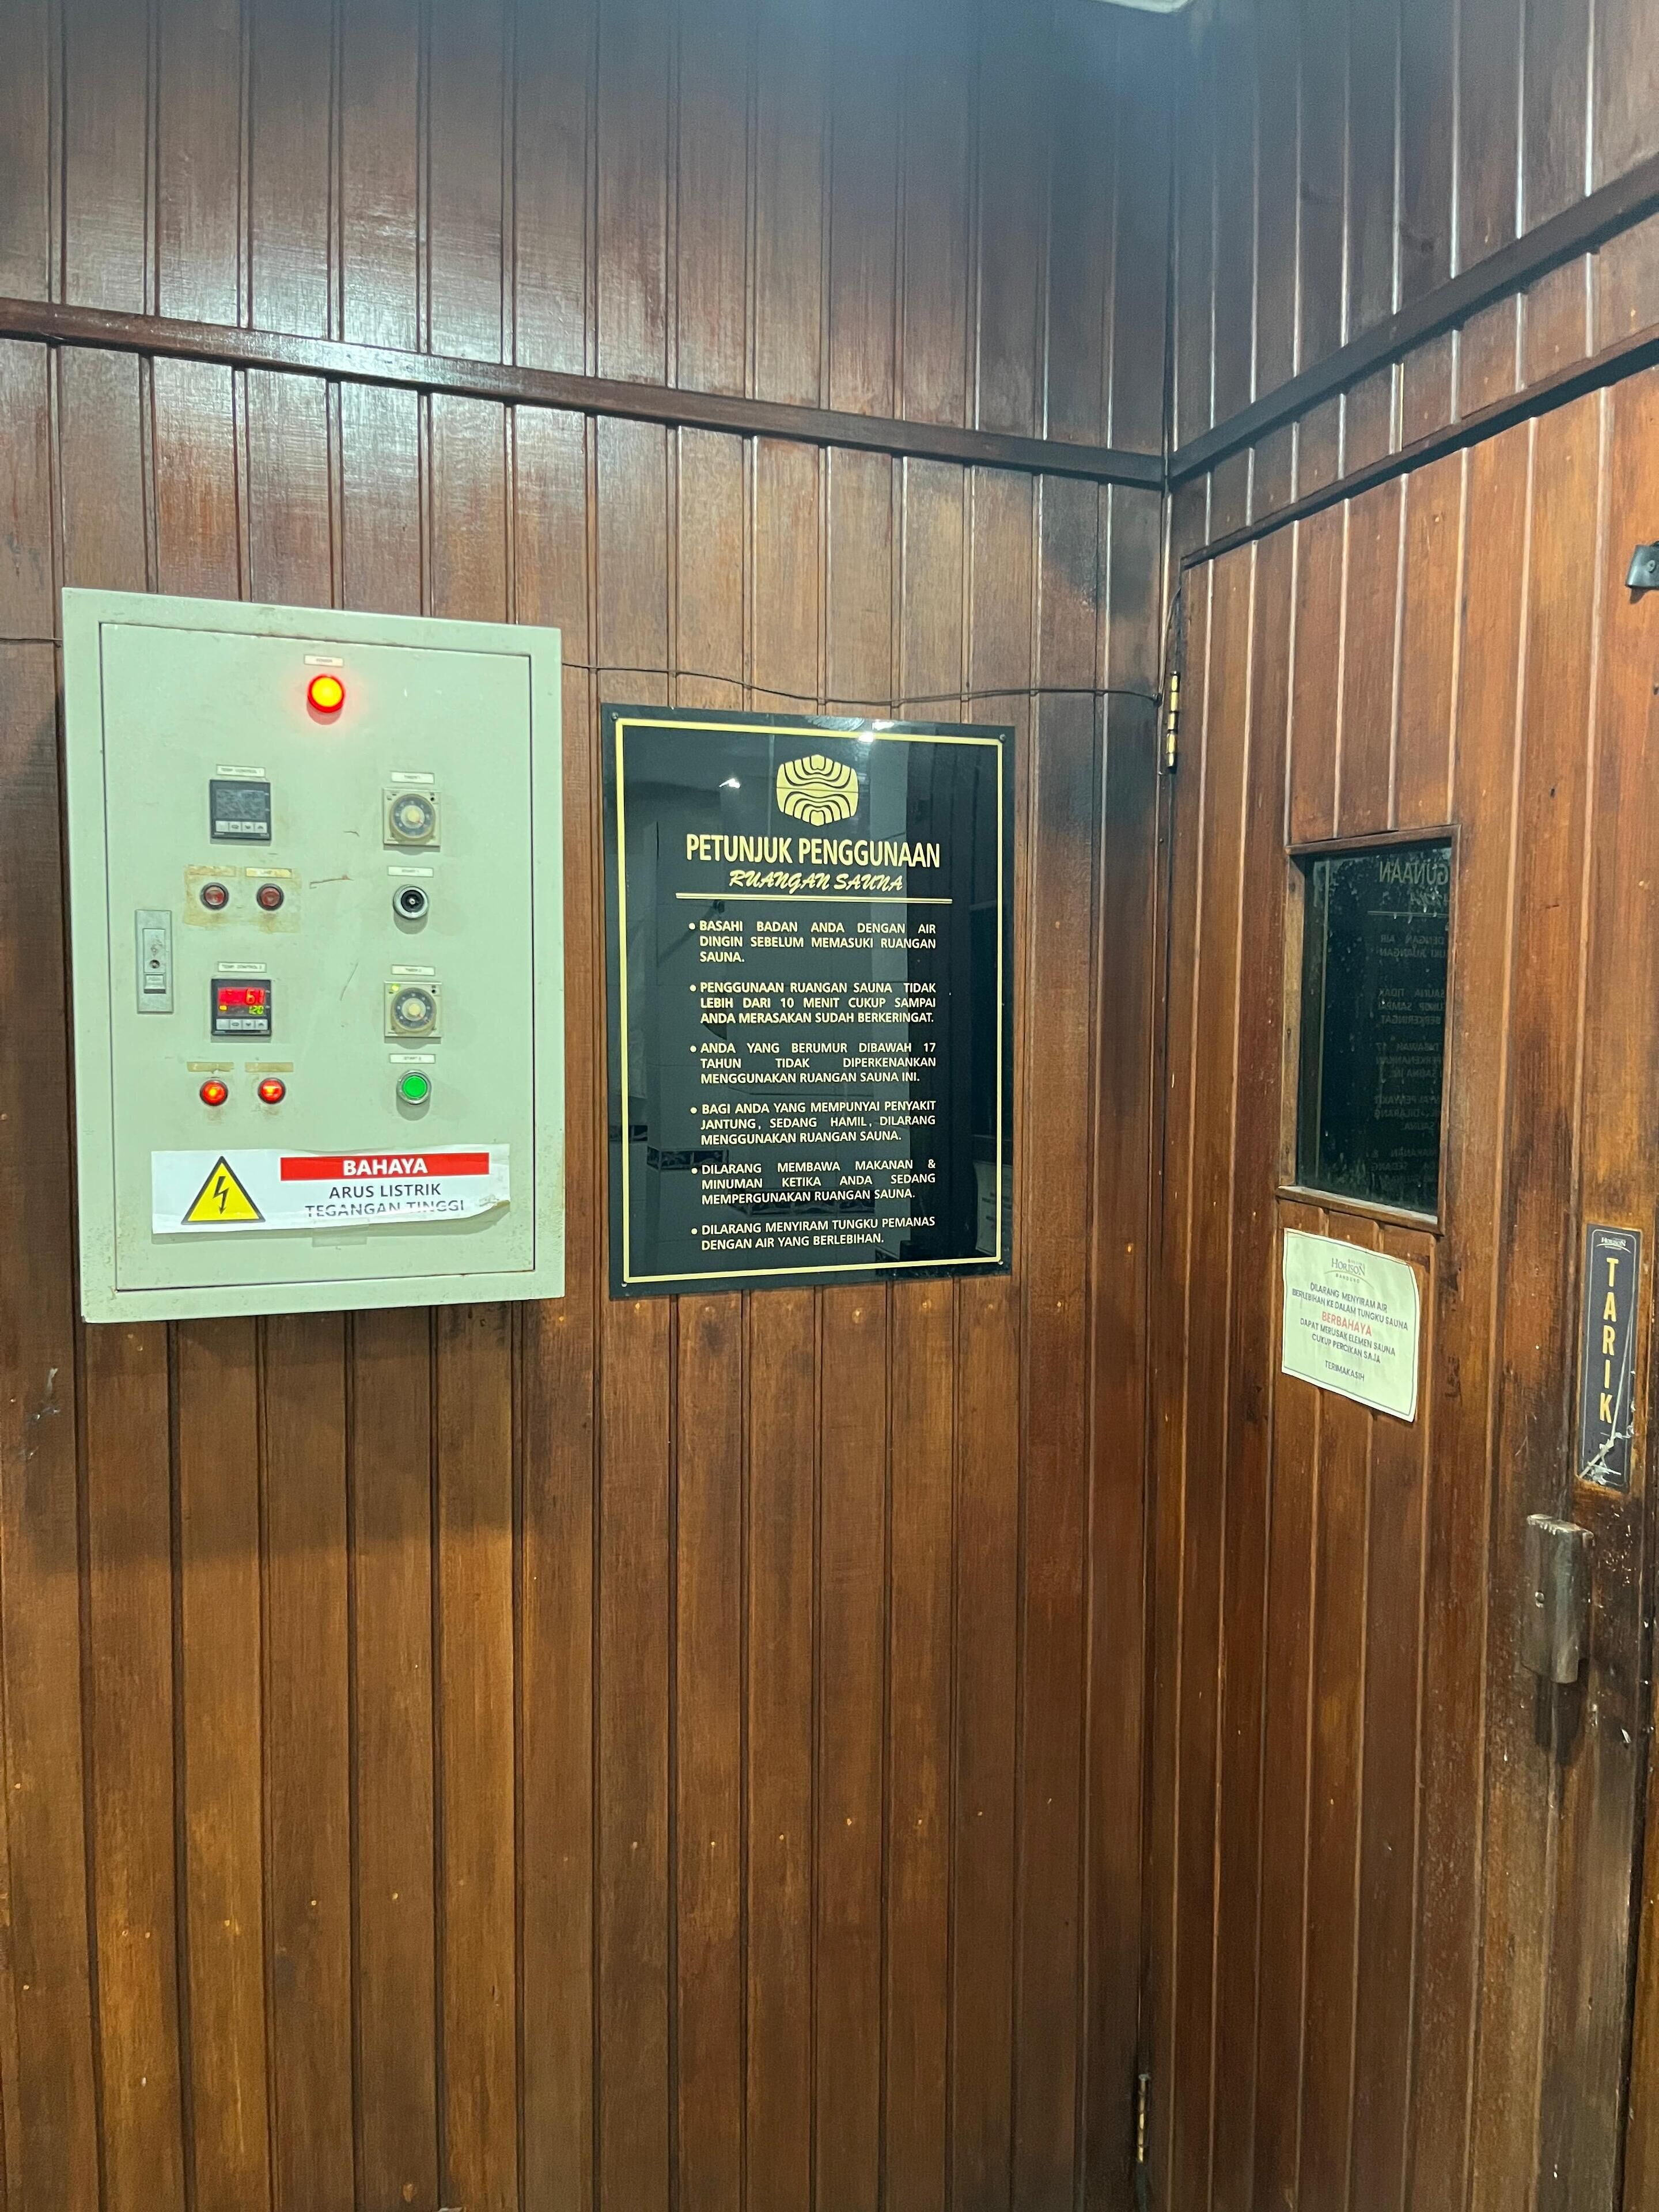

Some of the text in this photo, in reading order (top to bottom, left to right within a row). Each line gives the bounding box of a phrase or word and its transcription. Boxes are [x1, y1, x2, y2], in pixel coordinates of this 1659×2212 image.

[687, 834, 940, 867] PETUNJUK PENGGUNAAN
[729, 870, 903, 894] RUANGAN SAUNA
[700, 921, 935, 933] BASAHI BADAN ANDA DENGAN AIR
[700, 936, 935, 948] DINGIN SEBELUM MEMASUKI RUANGAN
[700, 952, 744, 962] SAUNA.
[700, 982, 935, 993] PENGGUNAAN RUANGAN SAUNA TIDAK
[701, 998, 935, 1008] LEBIH DARI 10 MENIT CUKUP SAMPAI
[700, 1013, 933, 1023] ANDA MERASAKAN SUDAH BERKERINGAT.
[700, 1043, 935, 1053] ANDA YANG BERUMUR DIBAWAH 17
[700, 1058, 935, 1068] TAHUN TIDAK DIPERKENANKAN
[701, 1072, 919, 1084] MENGGUNAKAN RUANGAN SAUNA INI.
[702, 1101, 936, 1114] BAGI ANDA YANG MEMPUNYAI PENYAKIT
[700, 1116, 935, 1130] JANTUNG, SEDANG HAMIL, DILARANG
[702, 1131, 901, 1145] MENGGUNAKAN RUANGAN SAUNA.
[343, 1158, 428, 1176] BAHAYA
[702, 1159, 935, 1175] DILARANG MEMBAWA MAKANAN &
[702, 1173, 935, 1190] MINUMAN KETIKA ANDA SEDANG
[329, 1184, 441, 1199] ARUS LISTRIK
[702, 1189, 915, 1205] MEMPERGUNAKAN RUANGAN SAUNA.
[702, 1217, 935, 1234] DILARANG MENYIRAM TUNGKU PEMANAS
[702, 1233, 884, 1250] DENGAN AIR YANG BERLEBIHAN.
[1310, 1282, 1387, 1313] DILARANG MENYIRAM AIR
[1293, 1289, 1408, 1330] BERLEBIHAN KE DALAM TUNGKU SAUNA
[1322, 1311, 1372, 1336] BERBAHAYA
[1300, 1318, 1395, 1355] DAPAT MERUSAK ELEMEN SAUNA
[1599, 1257, 1619, 1424] TARIK
[1312, 1334, 1380, 1363] CUKUP PERCIKAN SAJA
[1325, 1360, 1365, 1380] TERIMAKASIH
